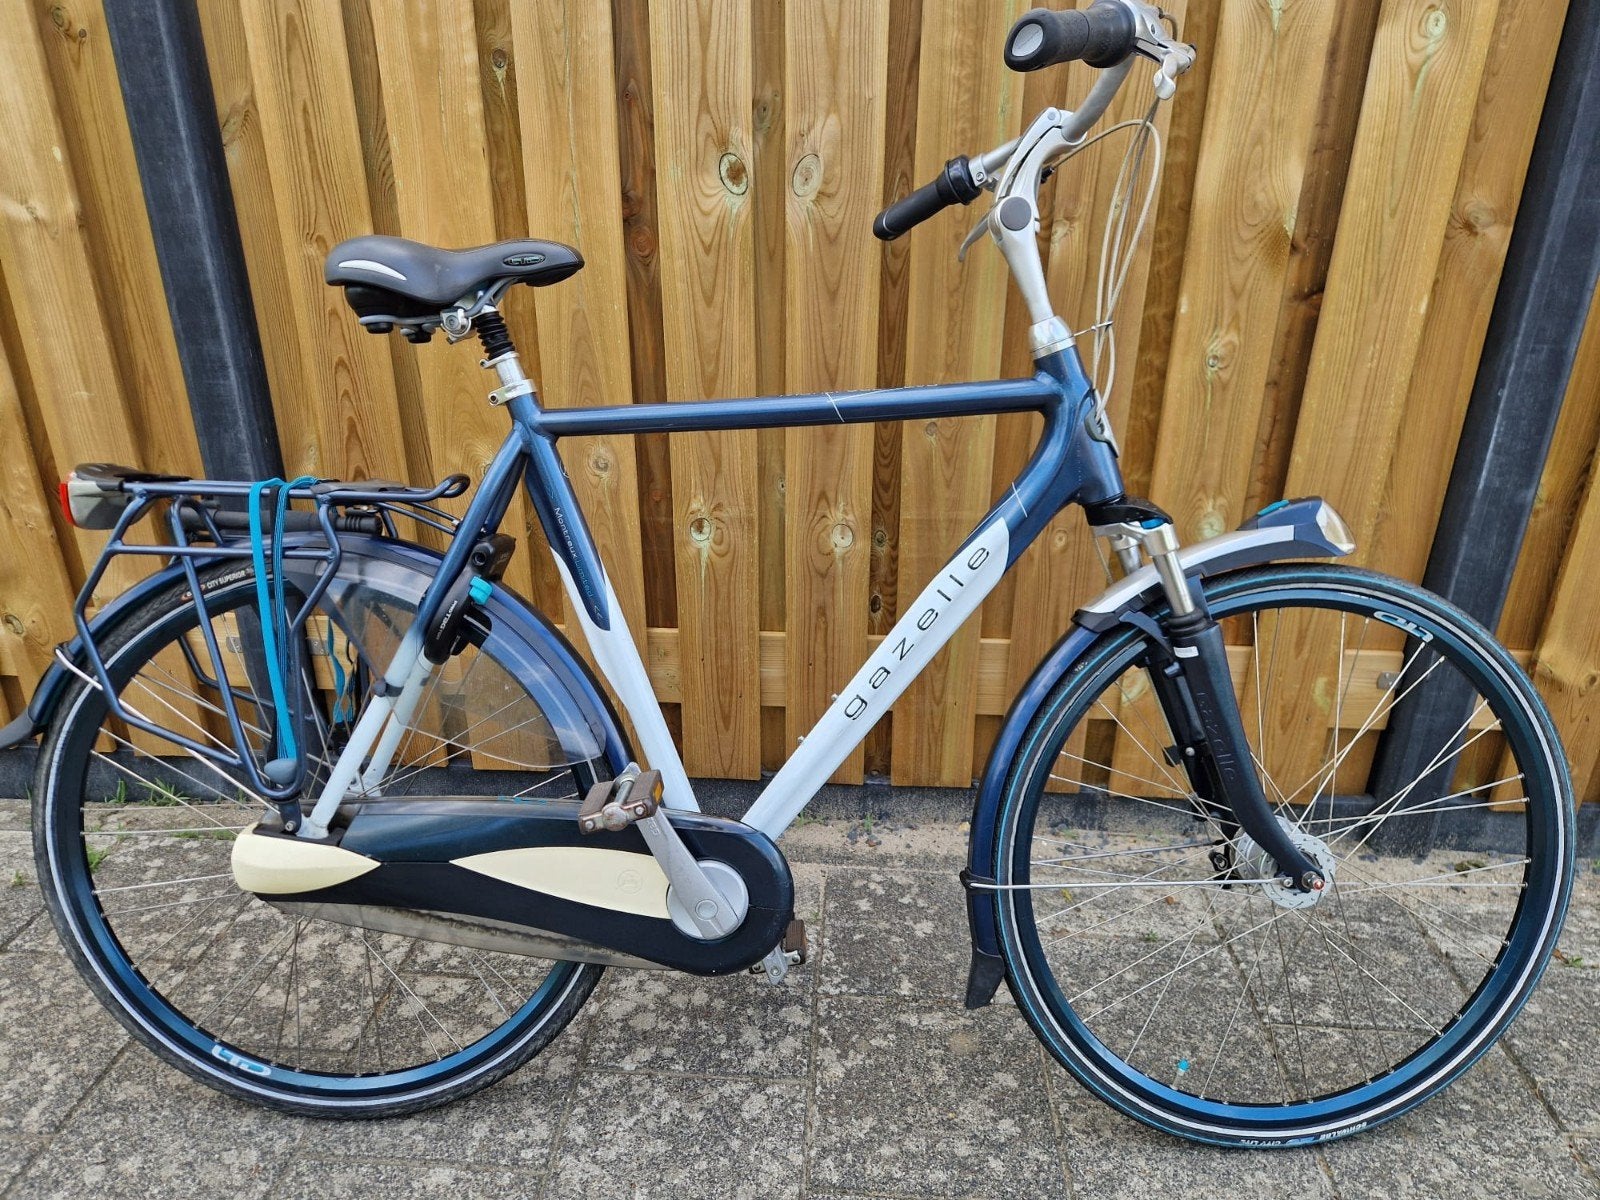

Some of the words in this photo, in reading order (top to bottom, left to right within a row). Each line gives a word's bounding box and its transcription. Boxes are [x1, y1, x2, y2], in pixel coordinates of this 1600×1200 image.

[206, 577, 219, 589] CITY
[218, 570, 247, 585] SUPERIOR
[554, 506, 579, 559] Montreux
[574, 559, 596, 599] Limited
[843, 547, 990, 721] gazelle
[1319, 1121, 1368, 1140] SCHWALBE
